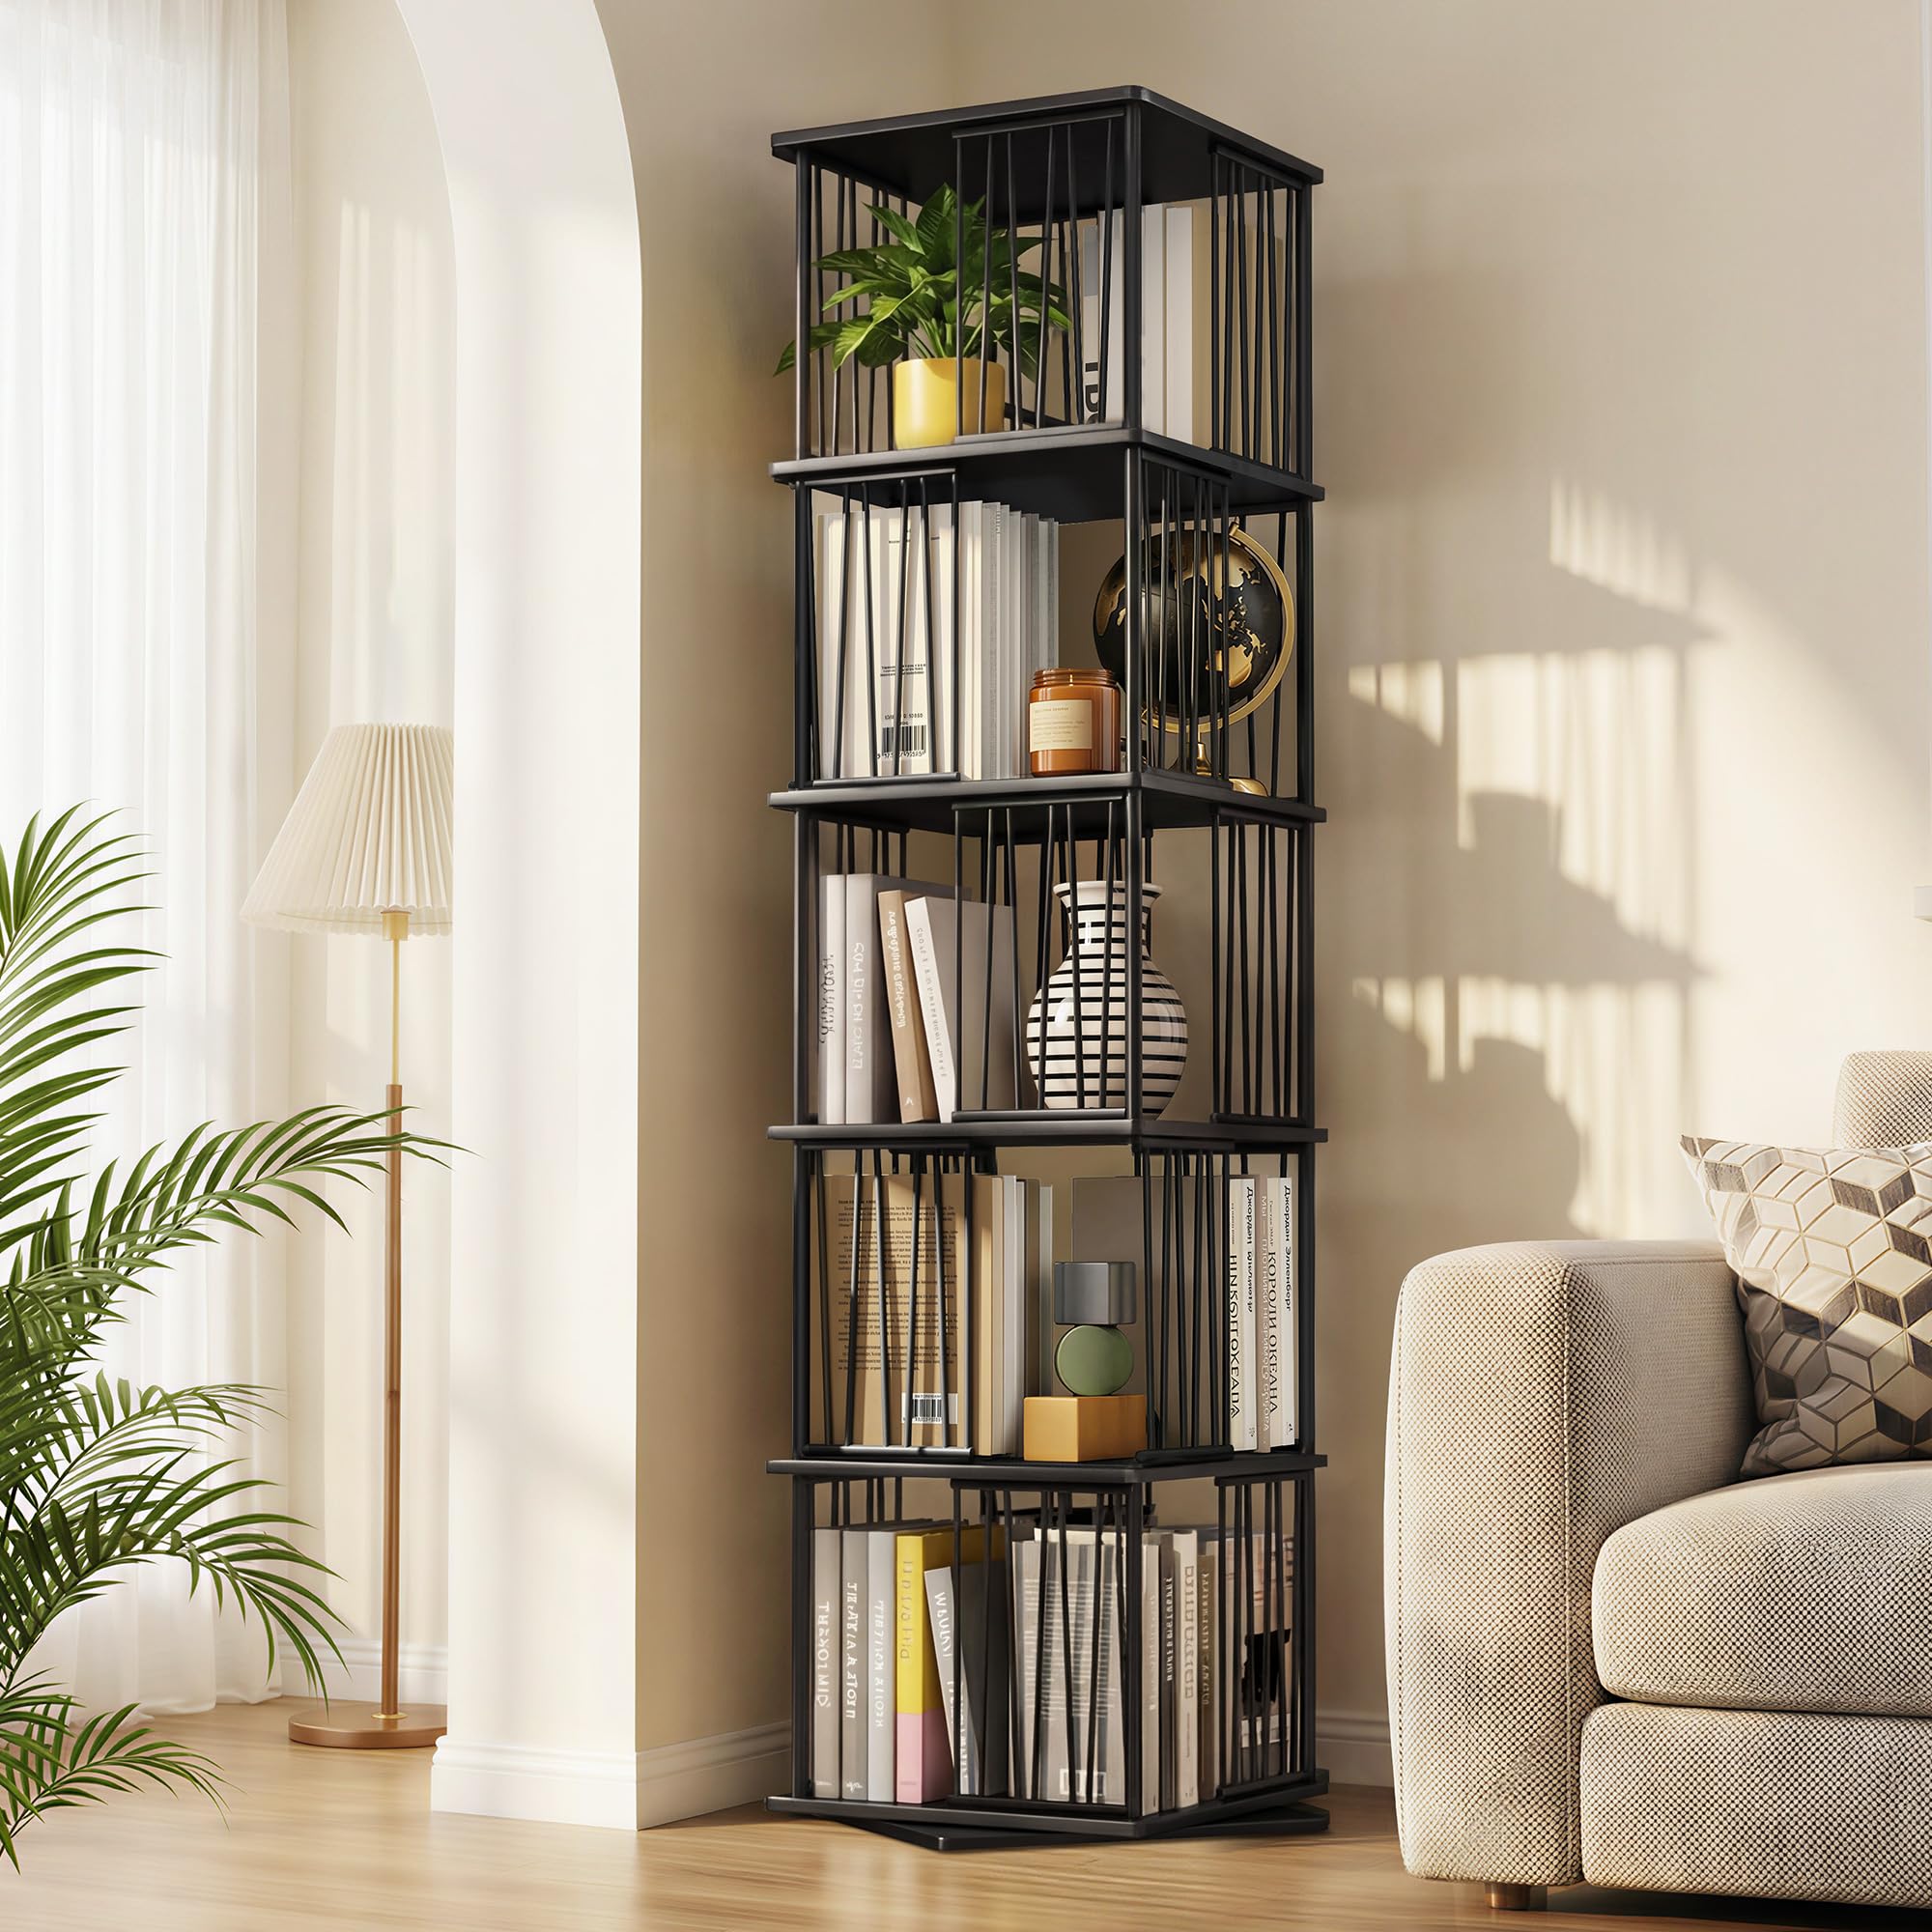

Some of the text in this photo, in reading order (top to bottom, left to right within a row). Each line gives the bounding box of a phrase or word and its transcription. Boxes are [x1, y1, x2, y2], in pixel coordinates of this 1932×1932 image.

[1261, 1195, 1267, 1217] МЫ
[1267, 1252, 1276, 1328] КОРОЛИ
[1269, 1334, 1278, 1414] ОКЕАНА
